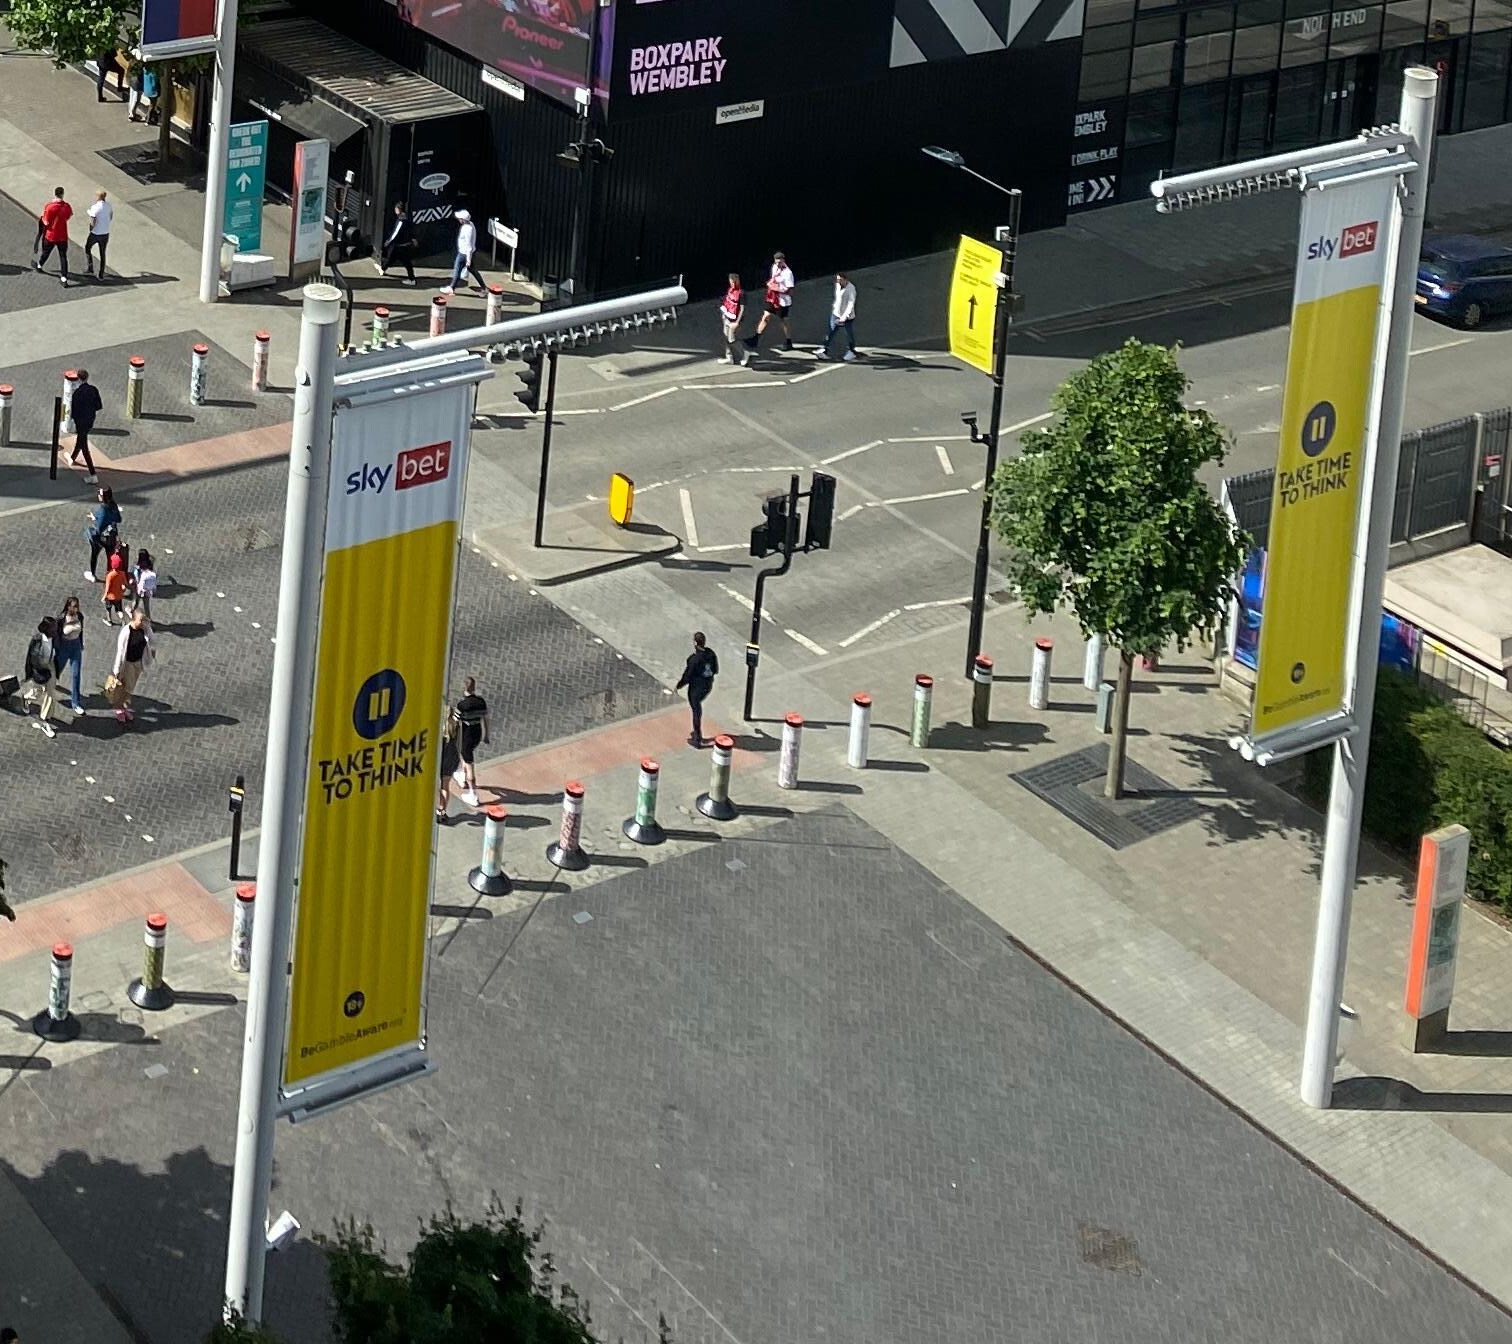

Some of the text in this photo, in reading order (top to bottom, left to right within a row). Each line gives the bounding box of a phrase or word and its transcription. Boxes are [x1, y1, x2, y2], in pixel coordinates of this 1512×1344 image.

[1343, 8, 1366, 26] END
[631, 36, 722, 71] BOXPARK
[630, 59, 727, 95] WEMBLEY
[1308, 226, 1373, 261] sky bet
[347, 449, 445, 495] sky bet
[1280, 451, 1351, 491] TAKE TIME
[1280, 472, 1347, 508] TO THINK
[319, 728, 429, 782] TAKE TIME
[323, 753, 424, 805] TO THINK
